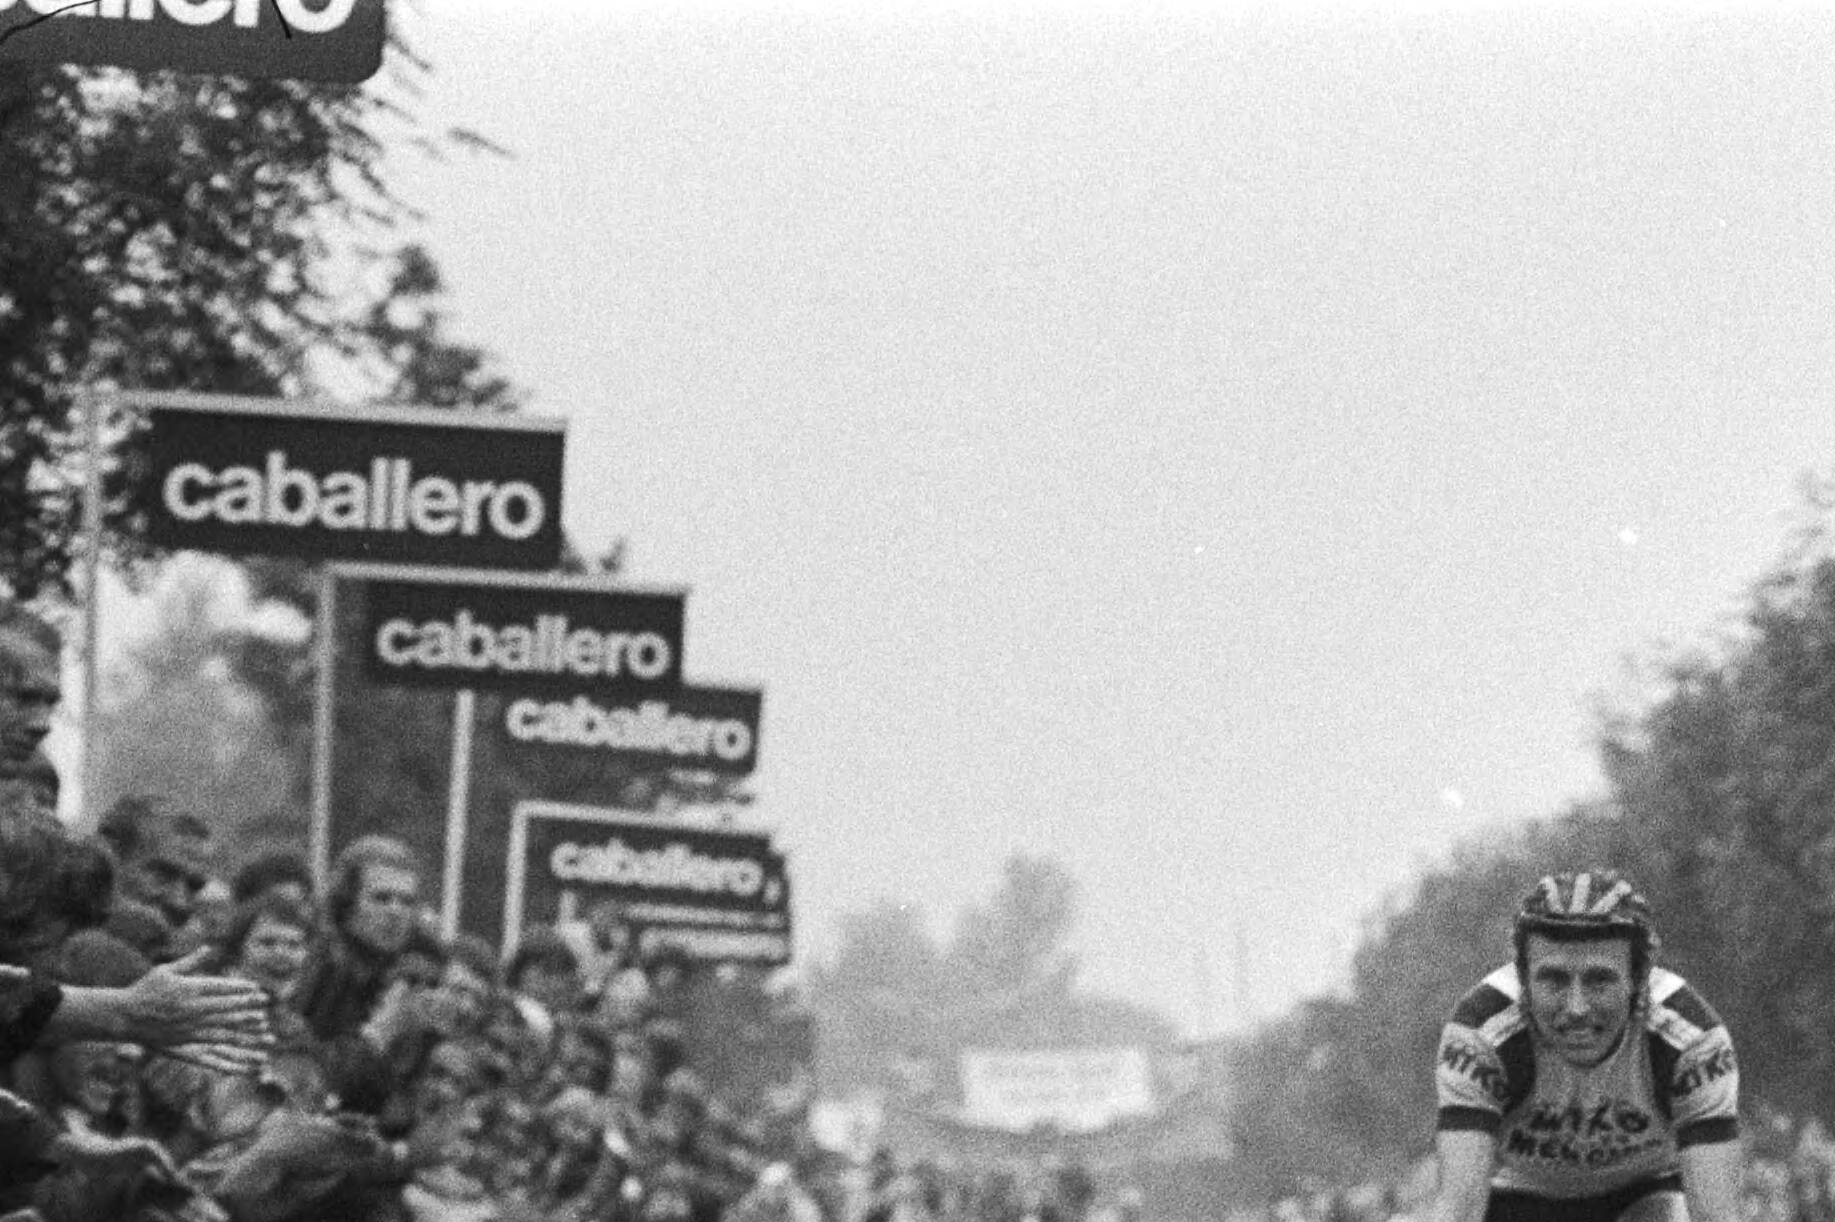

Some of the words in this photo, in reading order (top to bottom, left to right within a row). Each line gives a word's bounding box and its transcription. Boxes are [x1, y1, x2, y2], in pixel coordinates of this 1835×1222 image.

[163, 450, 546, 540] caballero
[377, 610, 670, 679] caballero
[507, 697, 750, 759] caballero
[552, 839, 763, 896] caballero
